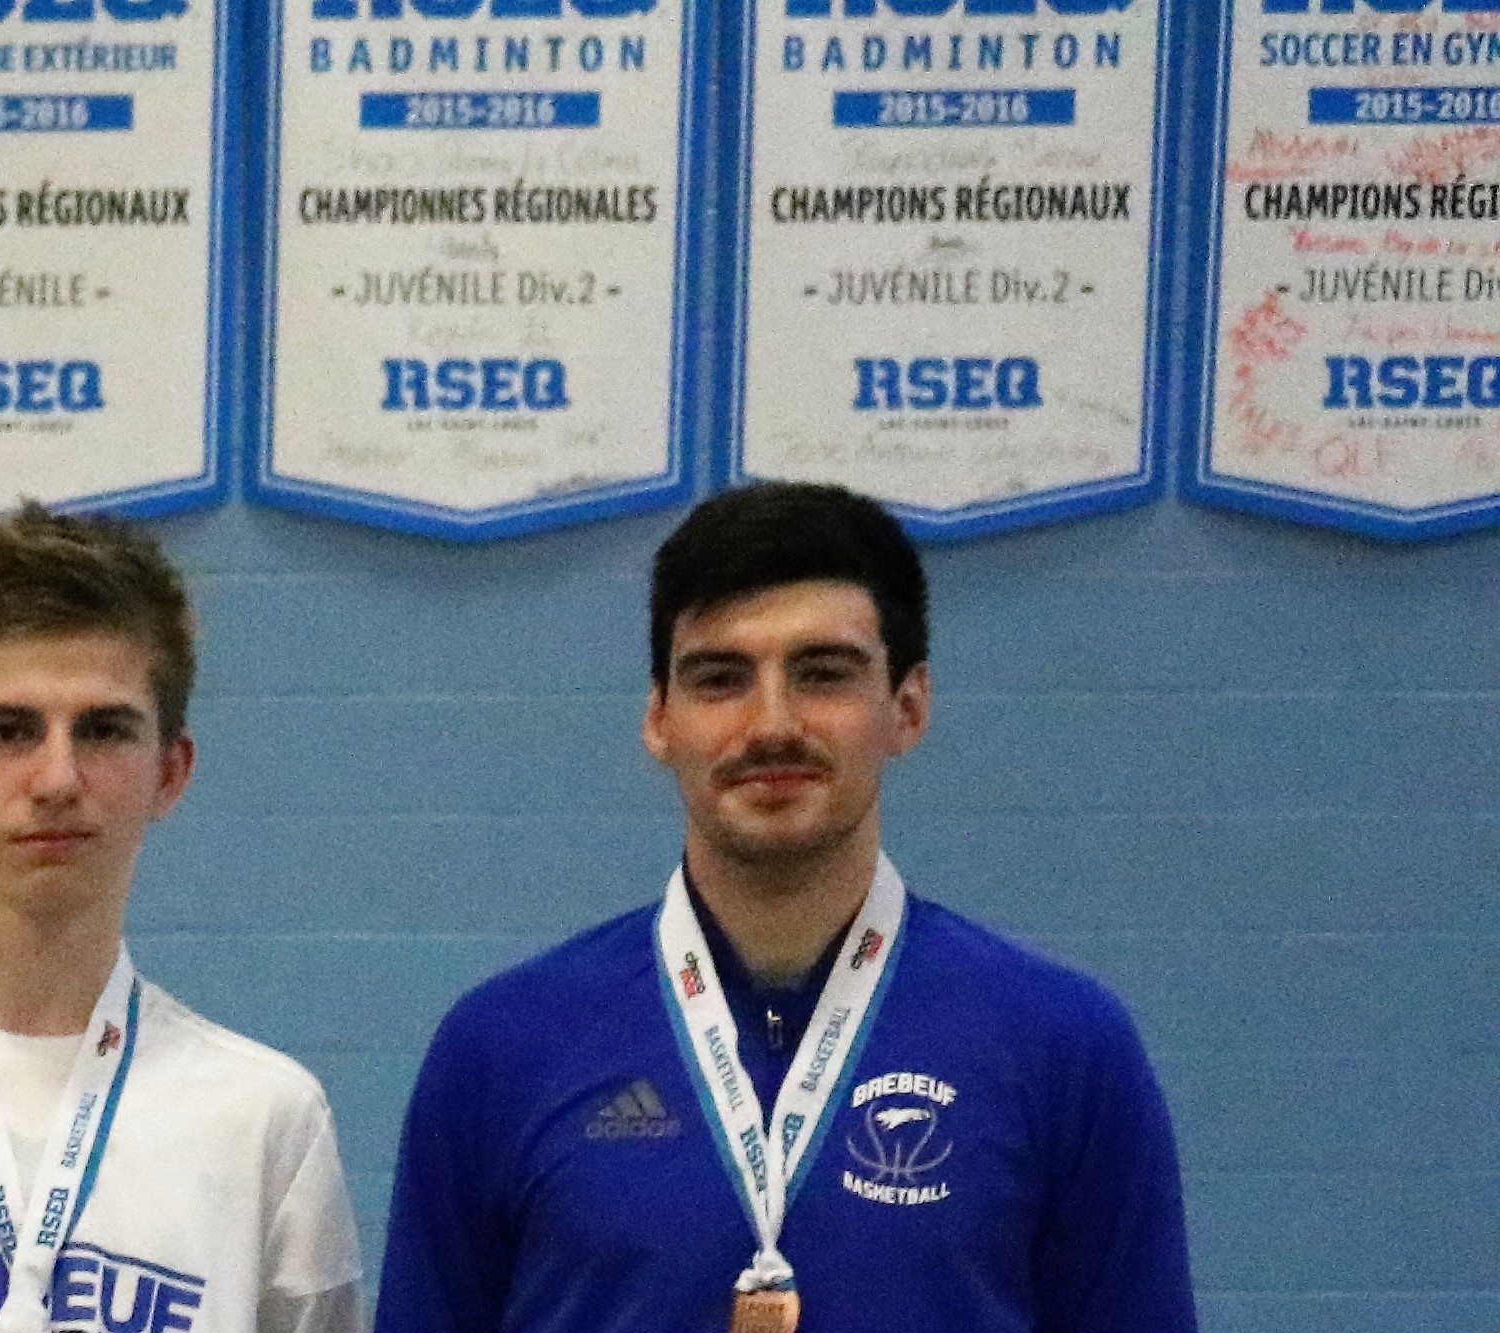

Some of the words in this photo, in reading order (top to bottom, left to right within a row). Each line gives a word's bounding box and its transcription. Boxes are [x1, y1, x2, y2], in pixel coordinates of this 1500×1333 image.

[22, 40, 175, 71] EXTÉRIEUR
[311, 36, 645, 72] BADMINTON
[782, 33, 1120, 70] BADMINTON
[1260, 33, 1381, 66] SOCCER
[1392, 33, 1432, 65] EN
[407, 95, 555, 125] 2015-2016
[879, 95, 1029, 121] 2015-2016
[16, 181, 189, 225] RÉGIONAUX
[299, 188, 485, 223] CHAMPIONNES
[494, 177, 658, 223] RÉGIONALES
[772, 187, 946, 222] CHAMPIONS
[955, 176, 1130, 221] RÉGIONAUX
[1244, 183, 1421, 219] CHAMPIONS
[383, 359, 570, 409] RSEQ
[854, 358, 1042, 409] RSEQ
[1323, 356, 1500, 407] RSEQ
[704, 1025, 745, 1113] BASKETBALL
[851, 1071, 956, 1108] BREBEUF
[843, 1170, 950, 1206] BASKETBALL
[37, 1187, 69, 1247] RSEQ
